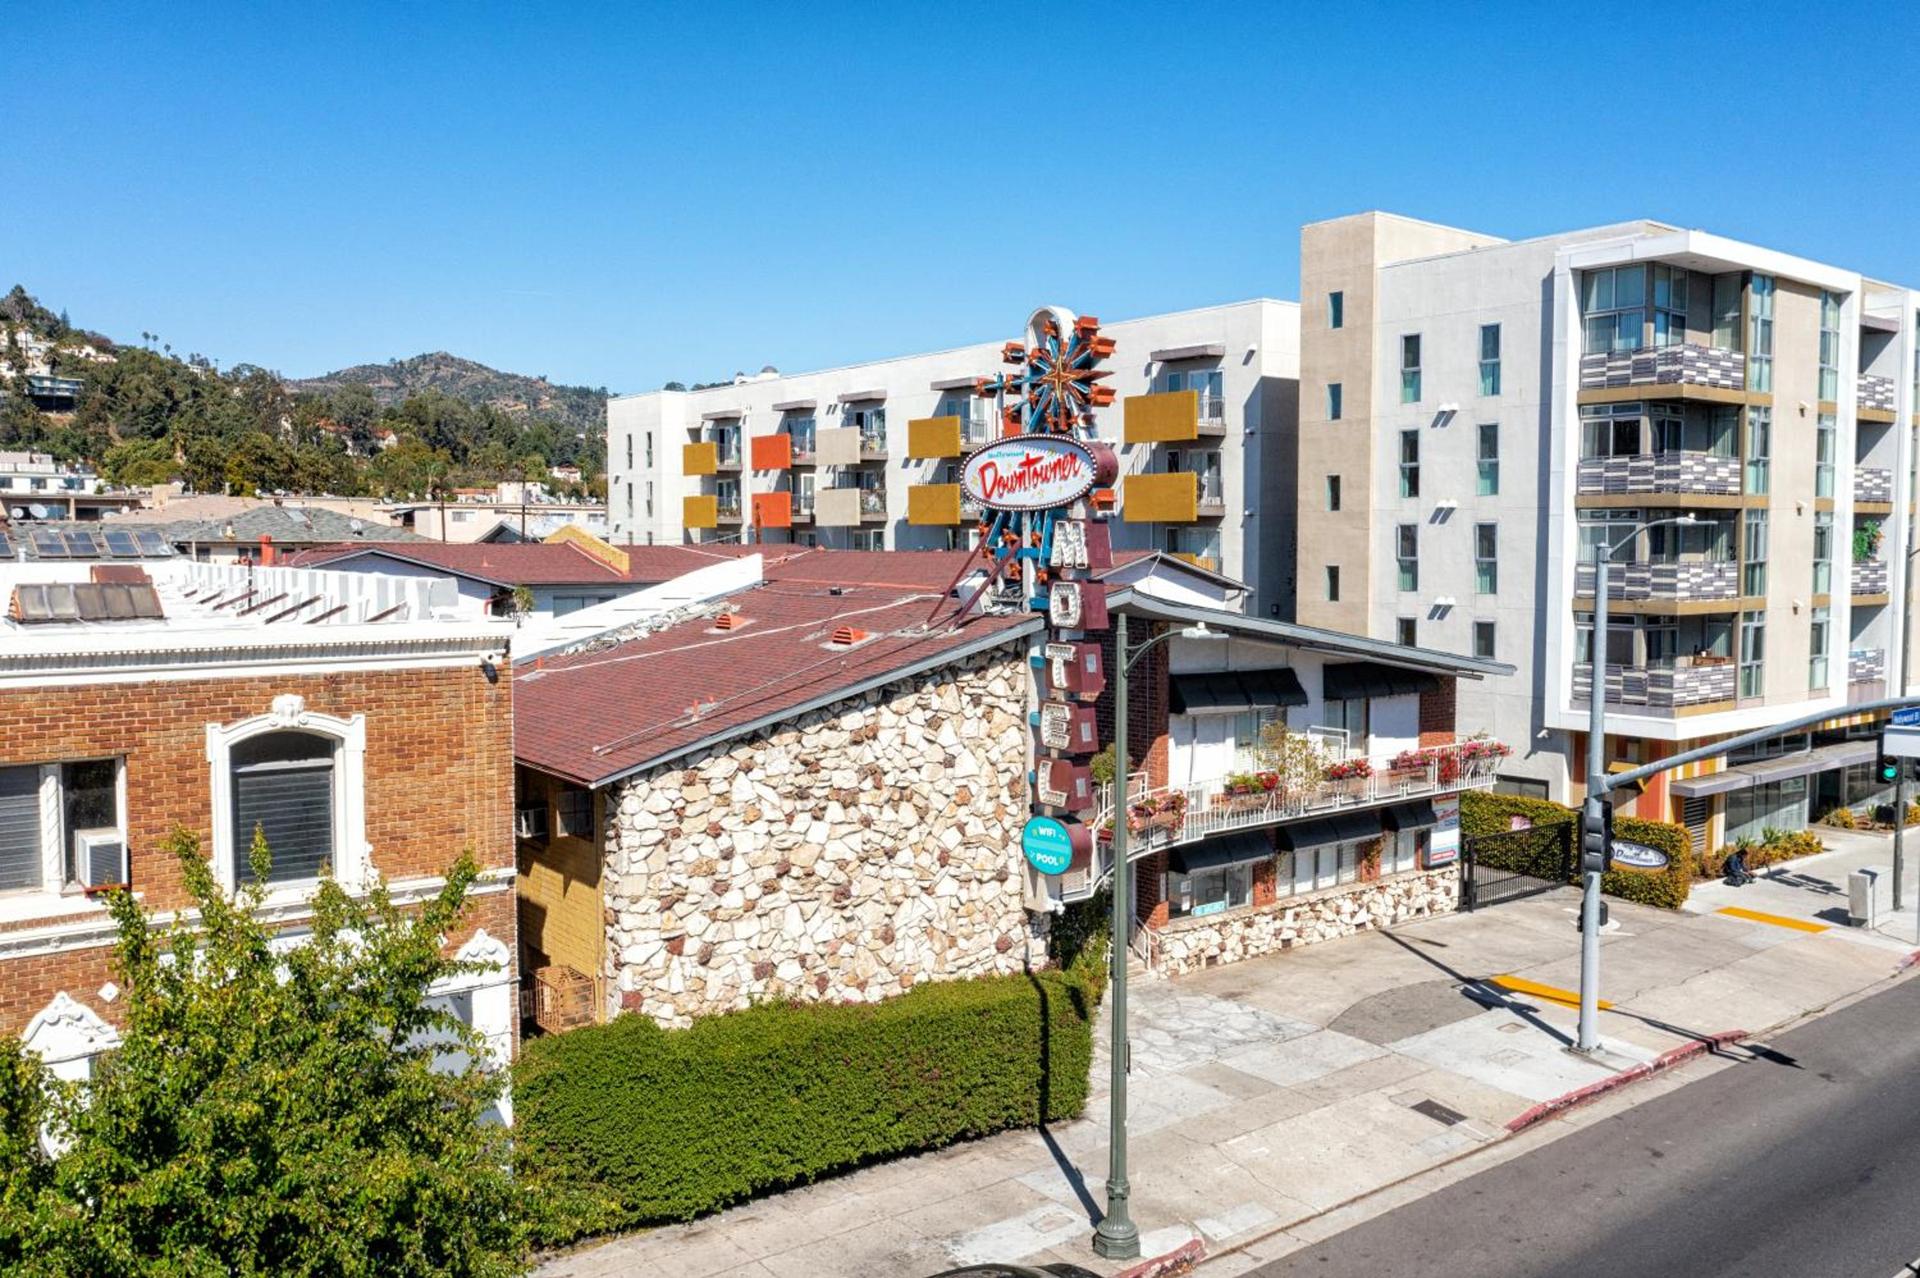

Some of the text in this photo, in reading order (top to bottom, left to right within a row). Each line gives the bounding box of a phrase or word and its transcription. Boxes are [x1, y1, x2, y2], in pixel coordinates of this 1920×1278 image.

[1037, 520, 1088, 808] MOTEL
[1038, 825, 1056, 838] WIFI
[1035, 852, 1059, 867] POOL
